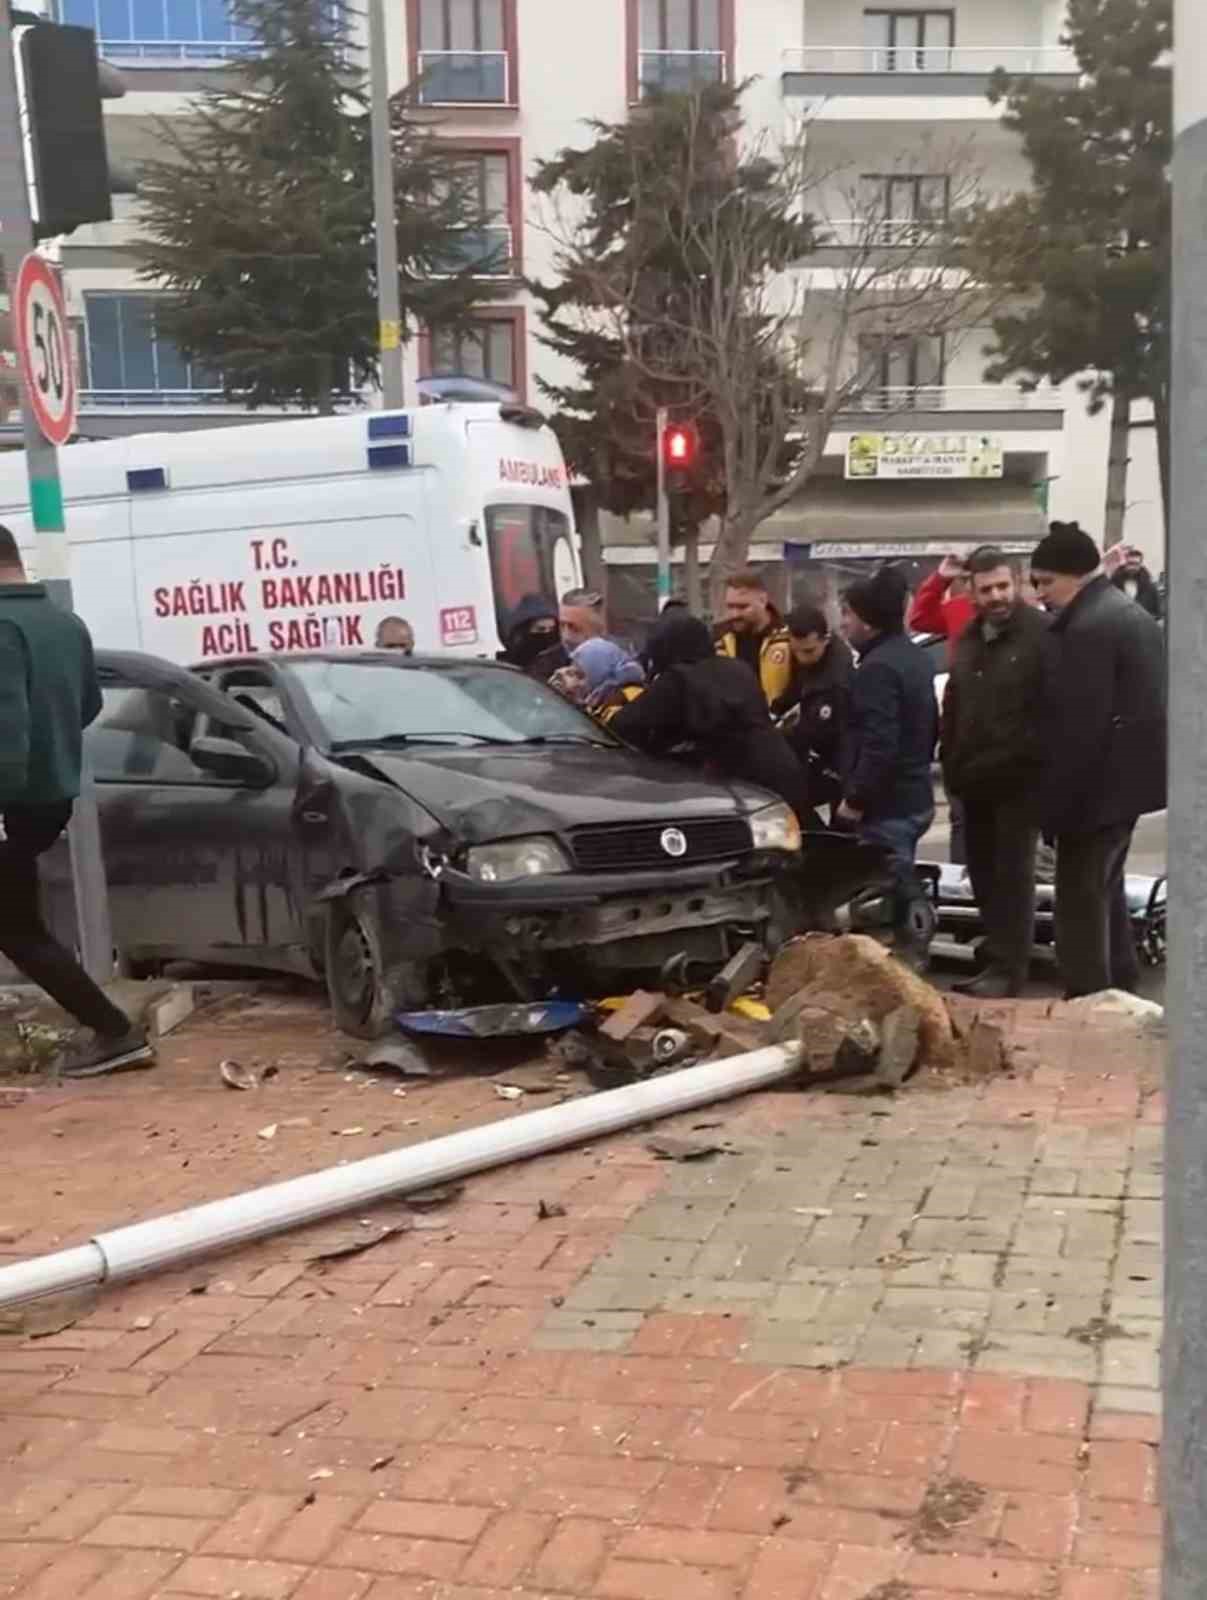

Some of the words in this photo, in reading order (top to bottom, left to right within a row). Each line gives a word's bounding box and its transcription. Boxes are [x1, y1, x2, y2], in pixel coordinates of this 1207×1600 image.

[33, 302, 64, 399] 50
[250, 538, 298, 570] T.C.
[154, 577, 246, 618] SAĞLIK
[261, 562, 406, 610] BAKANLIĞI
[202, 617, 259, 656] ACİL
[444, 610, 471, 630] 112
